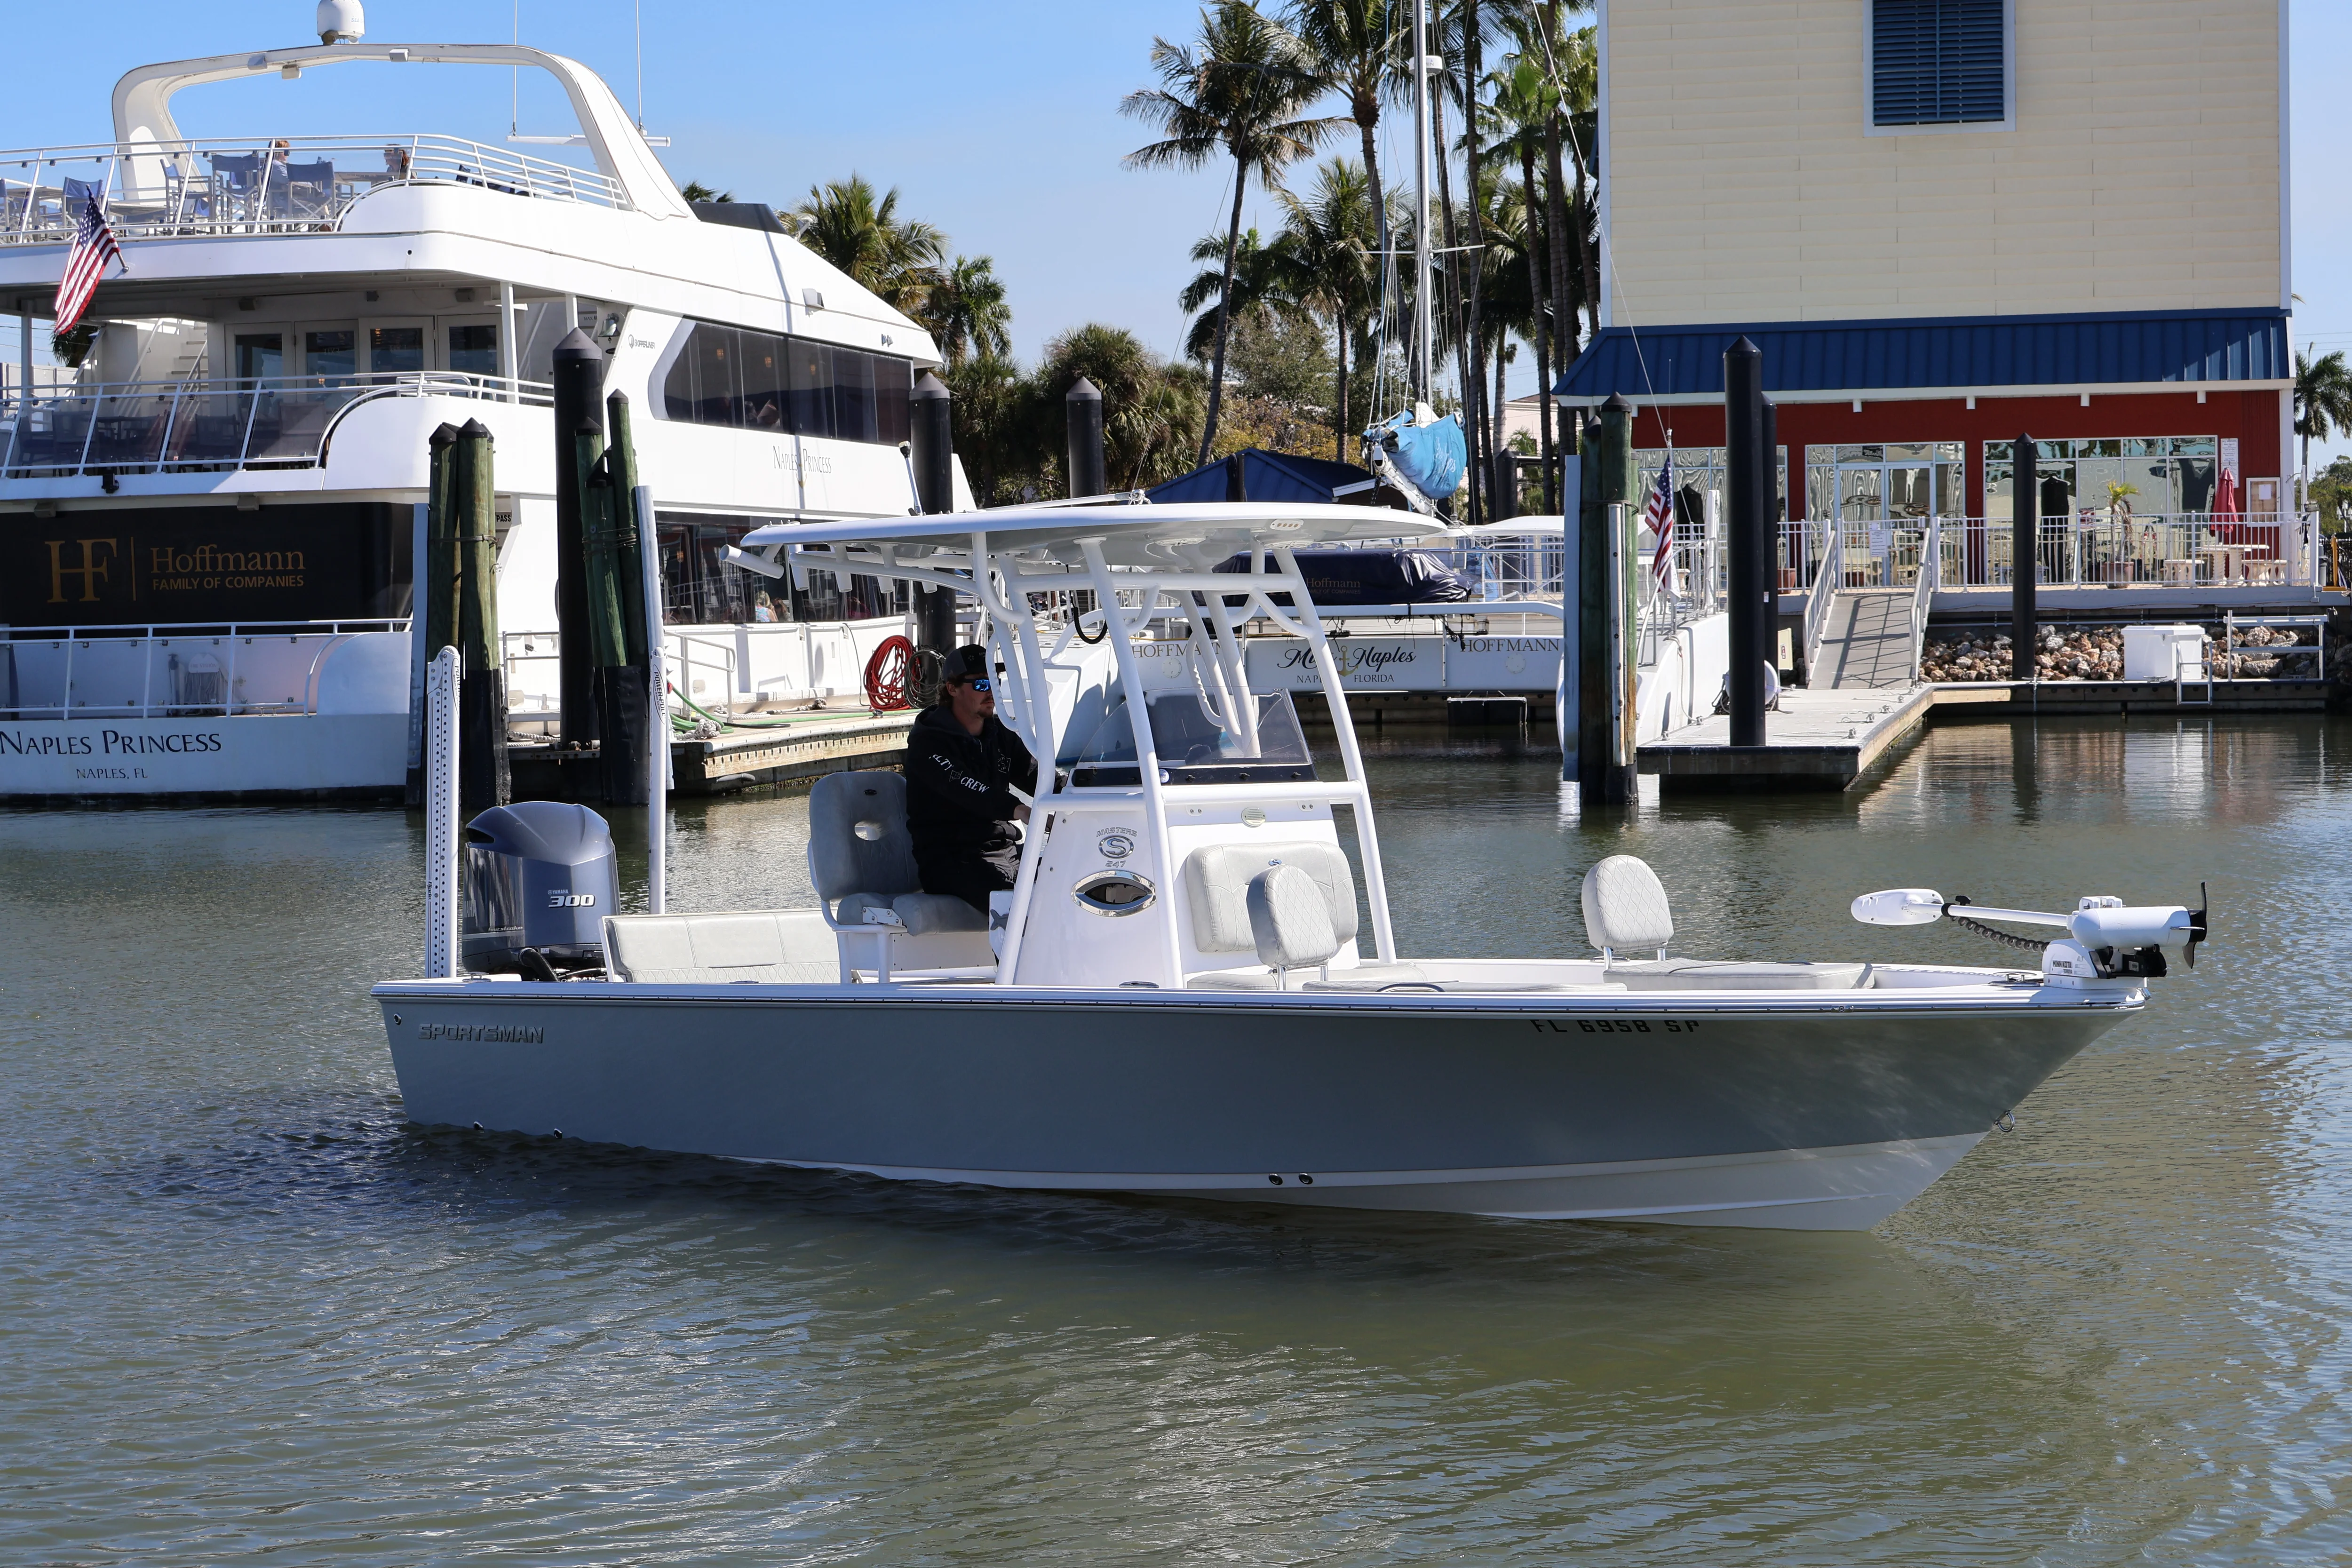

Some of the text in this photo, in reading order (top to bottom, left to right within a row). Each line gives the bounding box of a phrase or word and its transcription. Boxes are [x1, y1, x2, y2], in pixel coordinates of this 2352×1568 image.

[773, 446, 832, 474] NAPLES PRINCESS
[150, 544, 306, 573] Hoffmann
[153, 575, 304, 590] FAMILY OF COMPANIES
[1306, 577, 1360, 588] Hoffmann
[1460, 638, 1560, 652] HOFFMANN
[1347, 646, 1416, 672] Naples
[1354, 674, 1394, 683] FLORIDA
[654, 671, 666, 716] POWER-POLE
[0, 730, 222, 754] NAPLES PRINCESS
[76, 768, 148, 779] NAPLES, FL
[961, 777, 990, 793] CREW
[1096, 827, 1137, 837] MASTERS
[548, 895, 595, 907] 300
[418, 1023, 544, 1044] SPORTSMAN
[1529, 1019, 1700, 1033] FL 6958 SP
